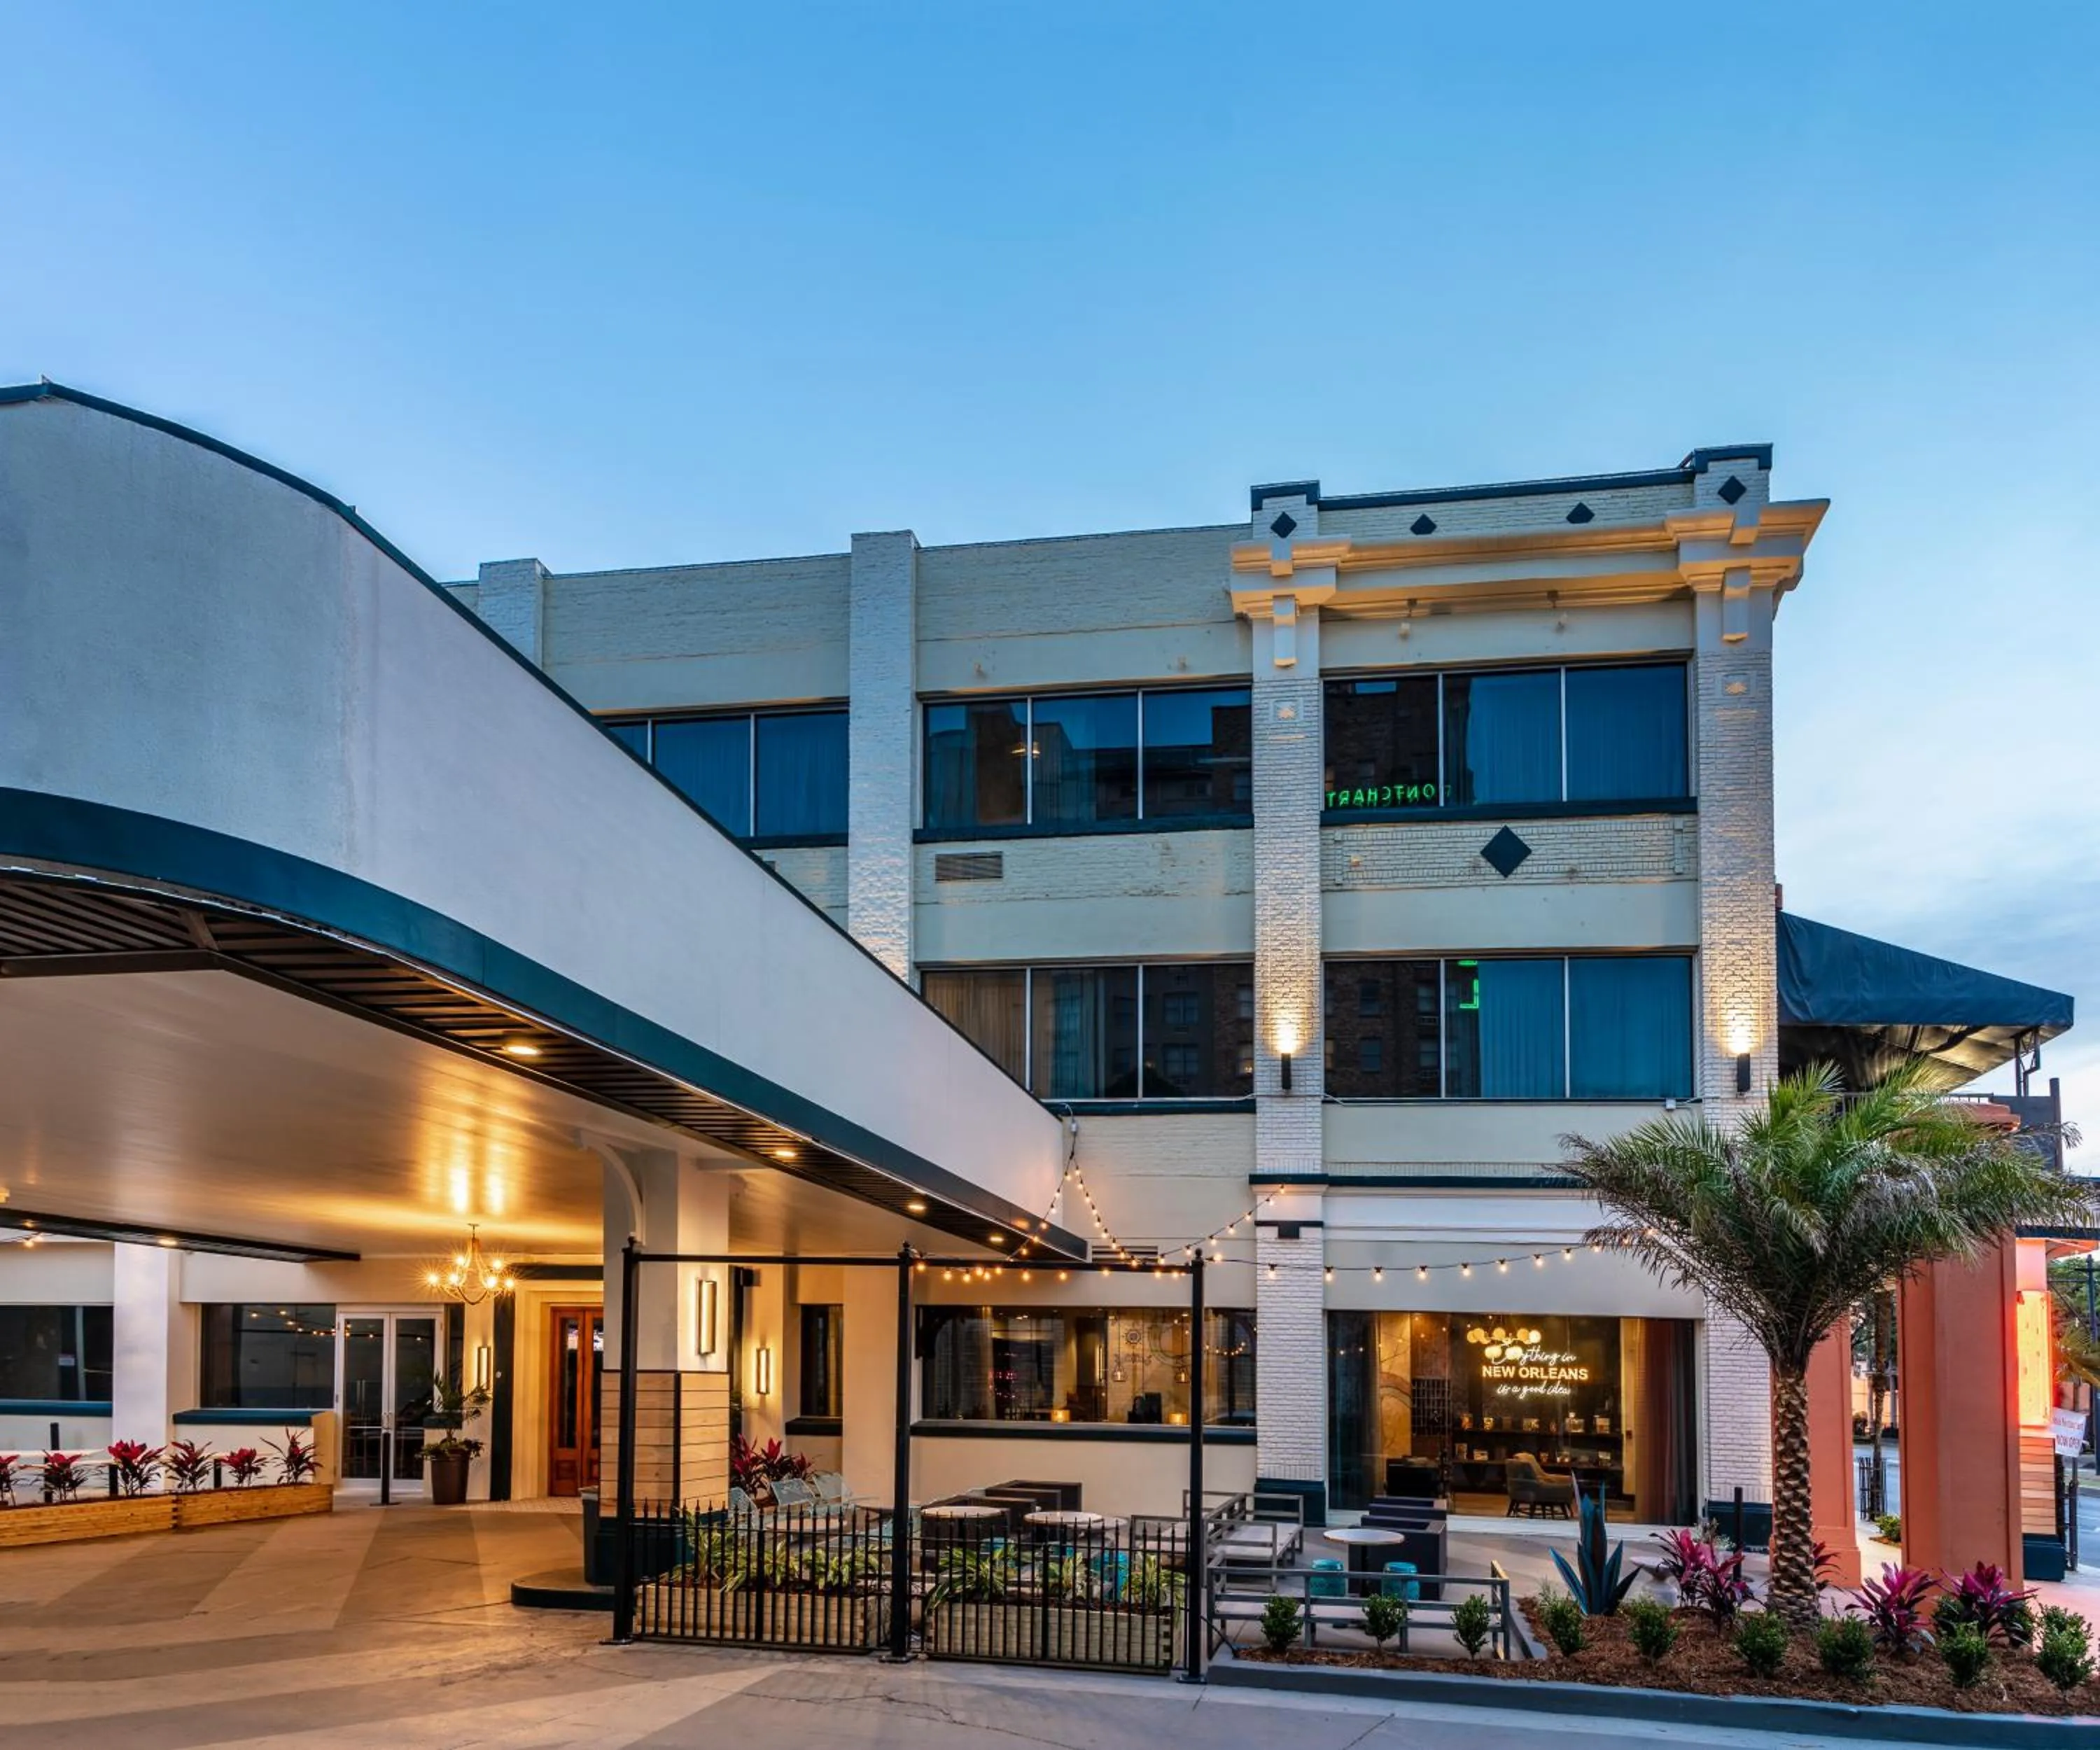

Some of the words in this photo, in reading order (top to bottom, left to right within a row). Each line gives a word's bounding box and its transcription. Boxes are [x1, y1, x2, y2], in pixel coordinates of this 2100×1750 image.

[1561, 1352, 1576, 1362] in
[1482, 1365, 1516, 1378] NEW
[1518, 1366, 1588, 1380] ORLEANS
[1497, 1383, 1510, 1394] is
[1519, 1379, 1546, 1399] good
[1547, 1380, 1571, 1395] idea
